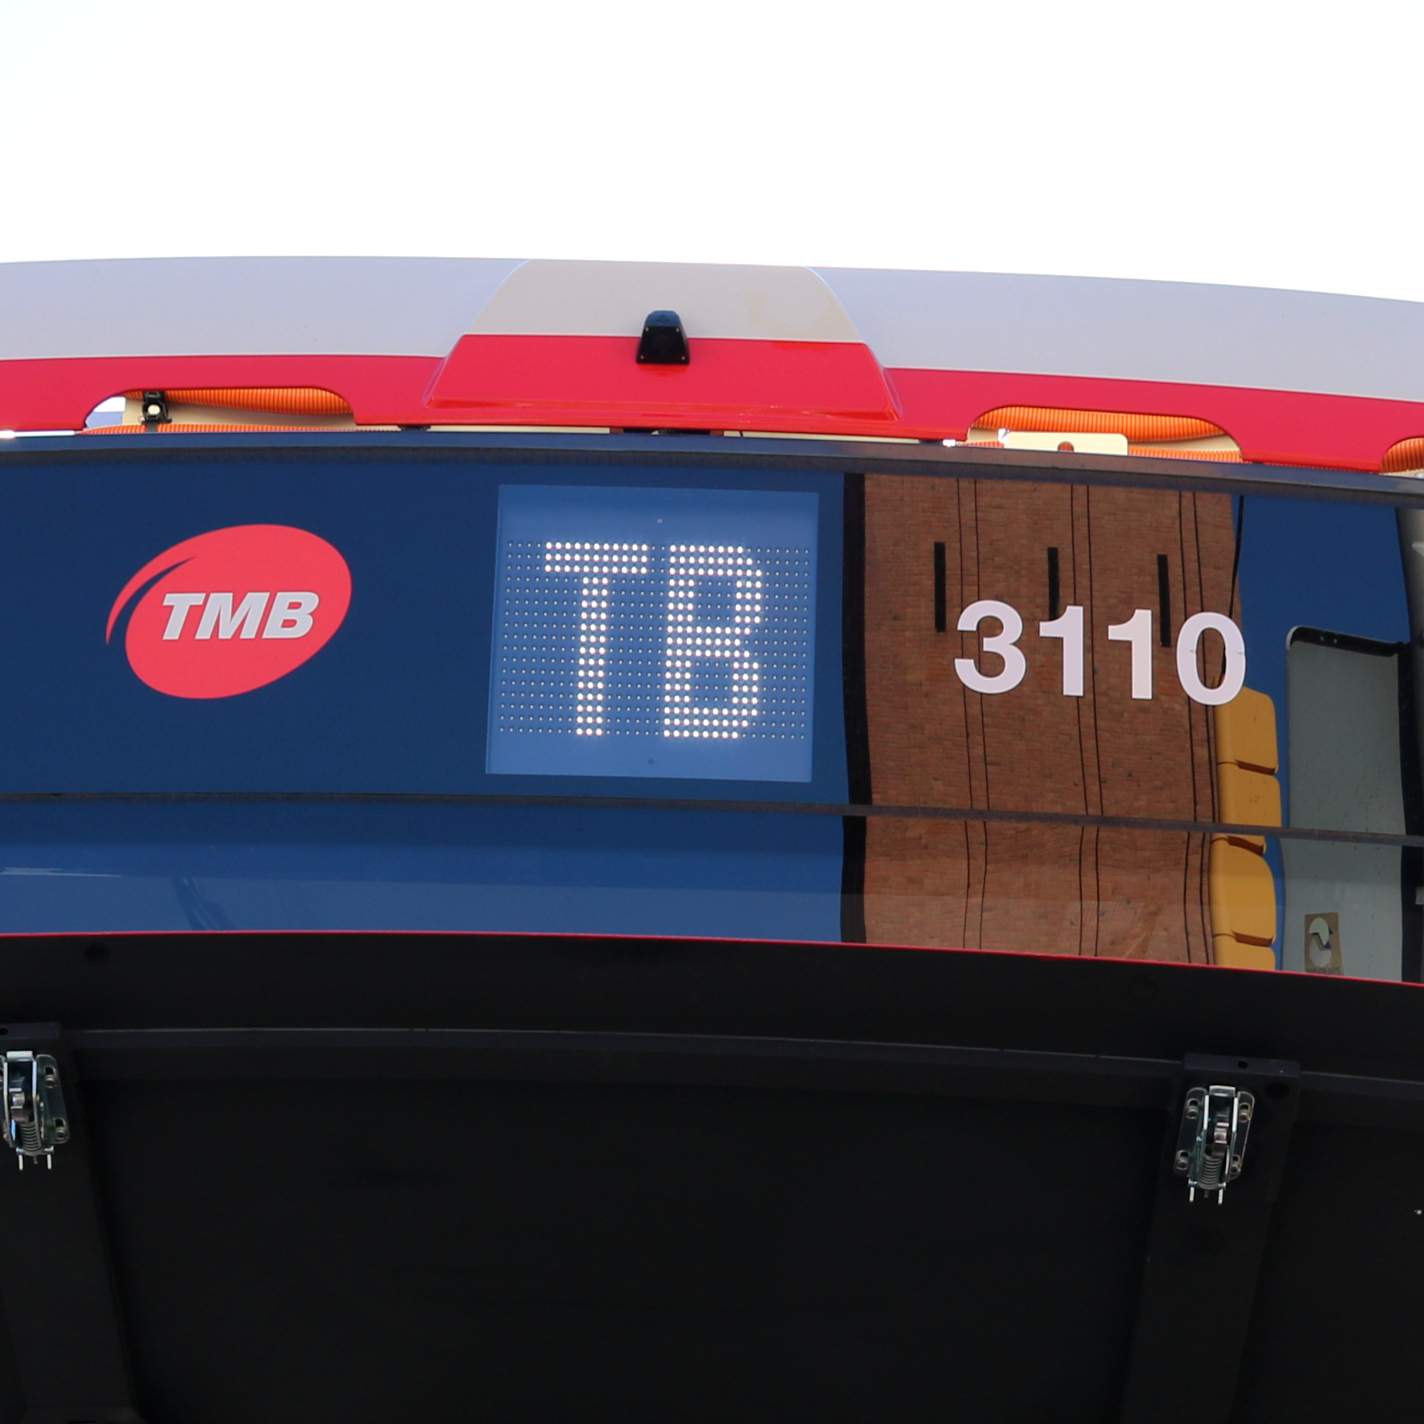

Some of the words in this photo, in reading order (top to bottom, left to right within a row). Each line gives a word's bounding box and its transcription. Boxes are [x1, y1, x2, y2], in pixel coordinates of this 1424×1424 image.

[162, 590, 318, 641] TMB
[542, 540, 766, 742] TB
[954, 600, 1247, 707] 3110
